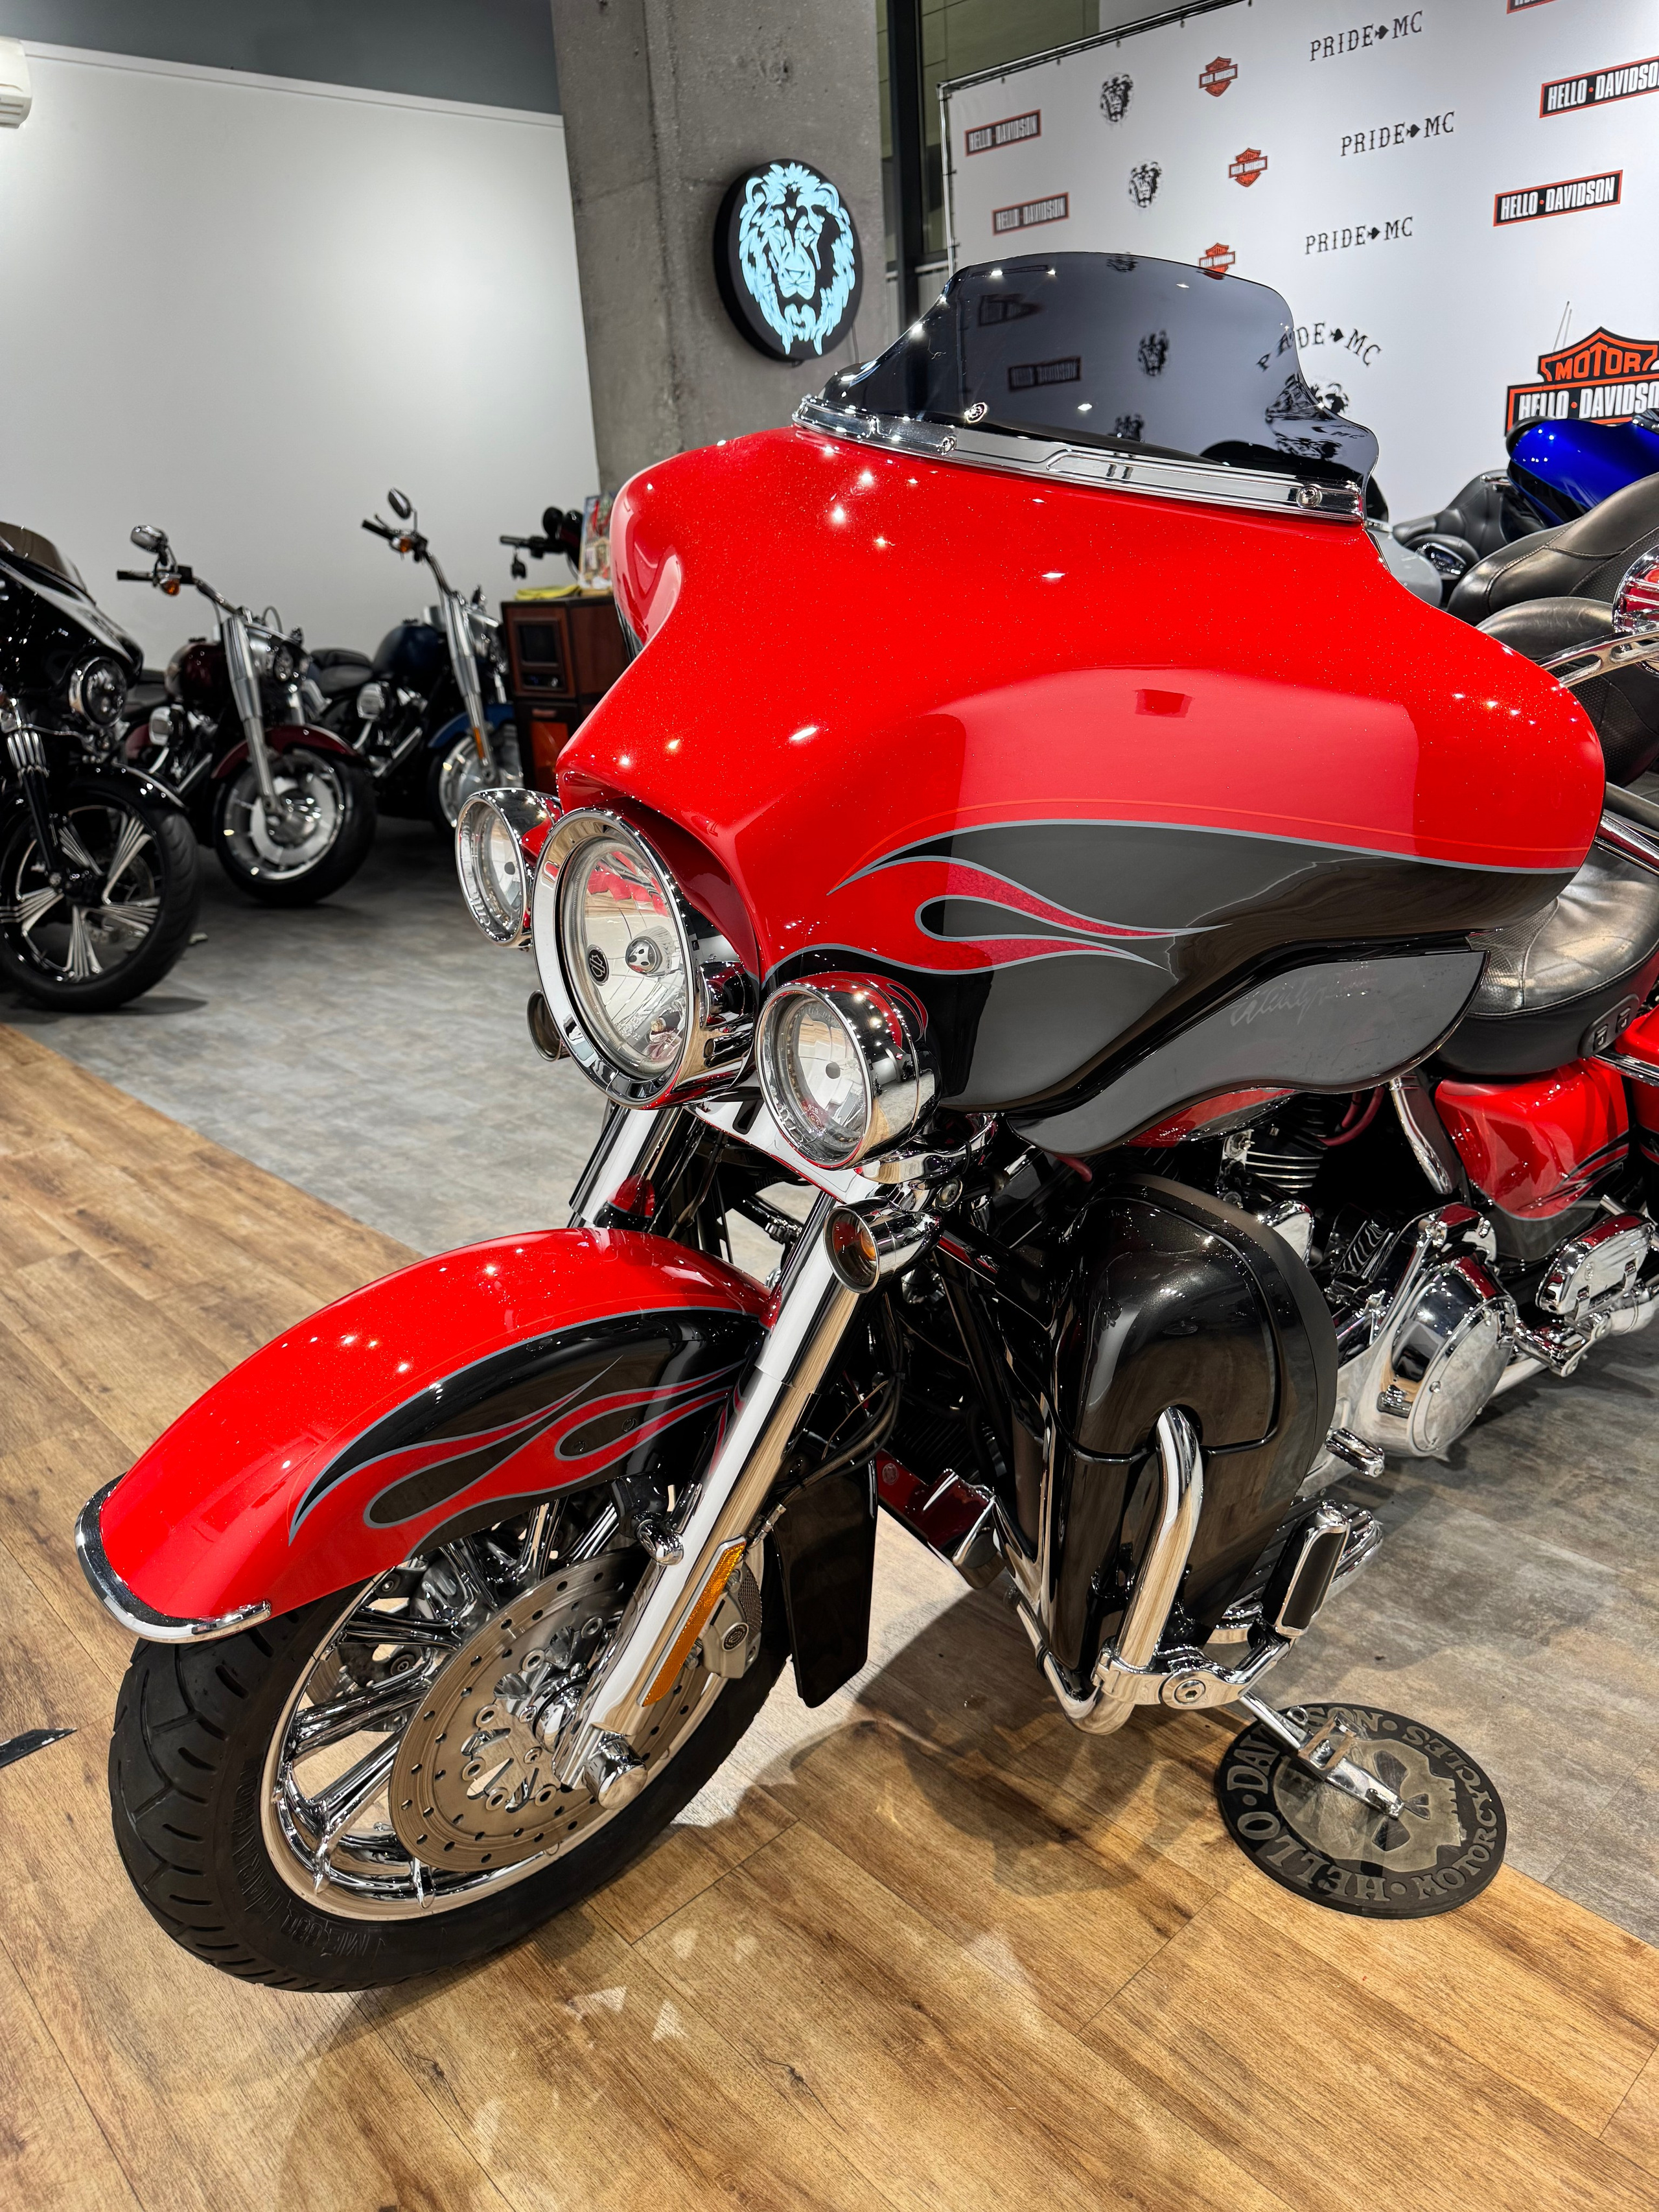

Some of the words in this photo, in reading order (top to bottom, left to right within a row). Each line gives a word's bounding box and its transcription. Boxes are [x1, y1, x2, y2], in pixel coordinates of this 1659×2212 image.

[1310, 23, 1374, 62] PRIDE
[1391, 10, 1422, 39] MC
[1548, 79, 1588, 111] HELLO
[1594, 62, 1659, 100] DAVIDSO
[1341, 122, 1406, 157] PRIDE
[1424, 111, 1455, 138] MC
[1500, 191, 1538, 220] HELLO
[1545, 177, 1616, 212] DAVIDSON
[1305, 226, 1366, 255] PRIDE
[1384, 216, 1413, 240] MC
[1344, 329, 1382, 367] MC
[1555, 342, 1641, 381] MOTOR
[1518, 390, 1570, 420] HELLO
[1227, 1706, 1384, 1794] DAVSON
[1402, 1726, 1498, 1900] MOTORCYCLES
[1237, 1811, 1391, 1902] HELLO
